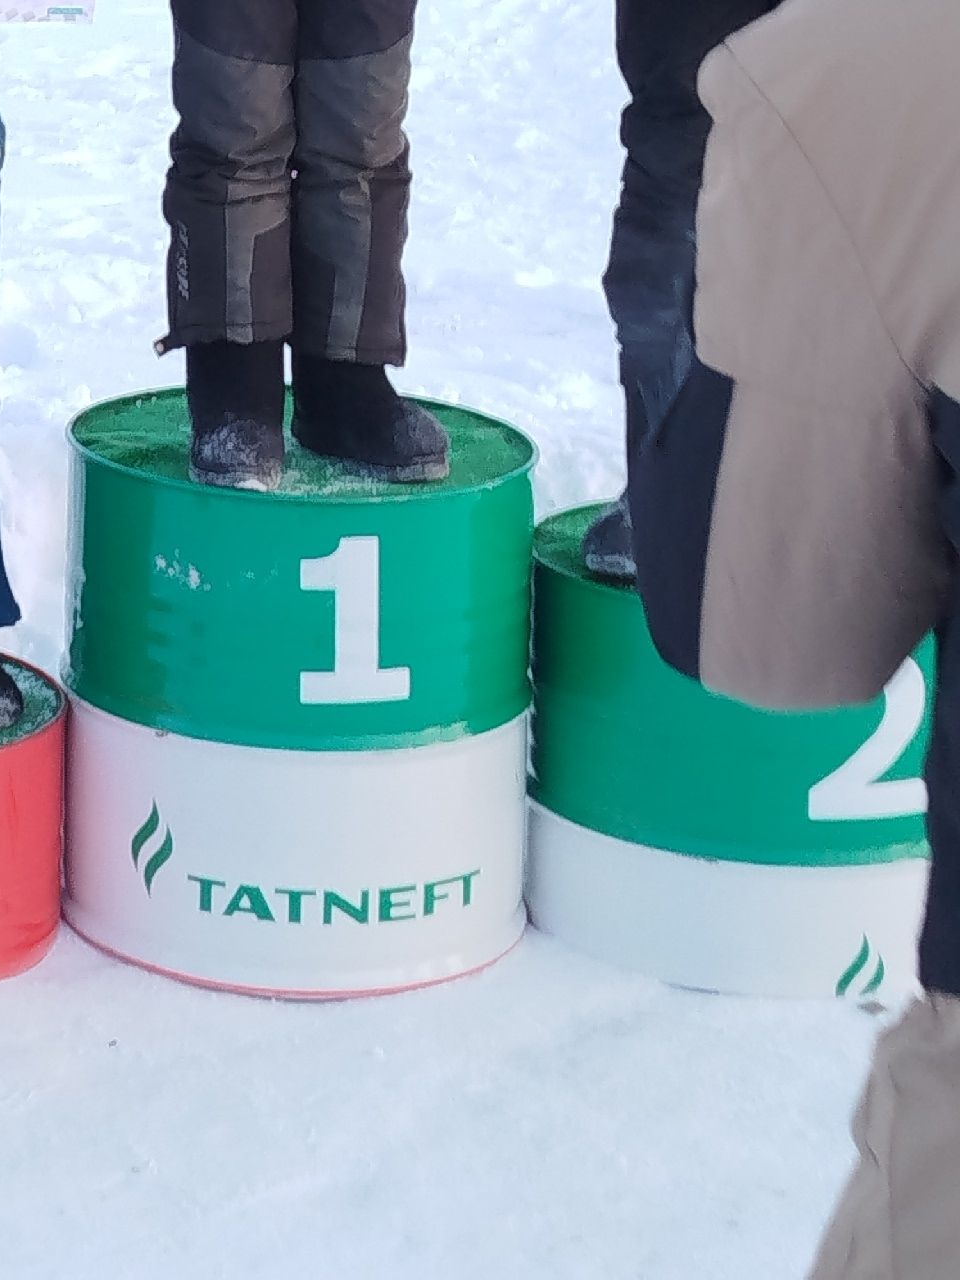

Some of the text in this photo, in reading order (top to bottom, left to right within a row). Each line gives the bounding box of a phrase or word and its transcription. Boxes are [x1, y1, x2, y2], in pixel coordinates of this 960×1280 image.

[299, 535, 411, 705] 1
[808, 656, 928, 821] 2
[187, 868, 481, 924] TATNEFT
